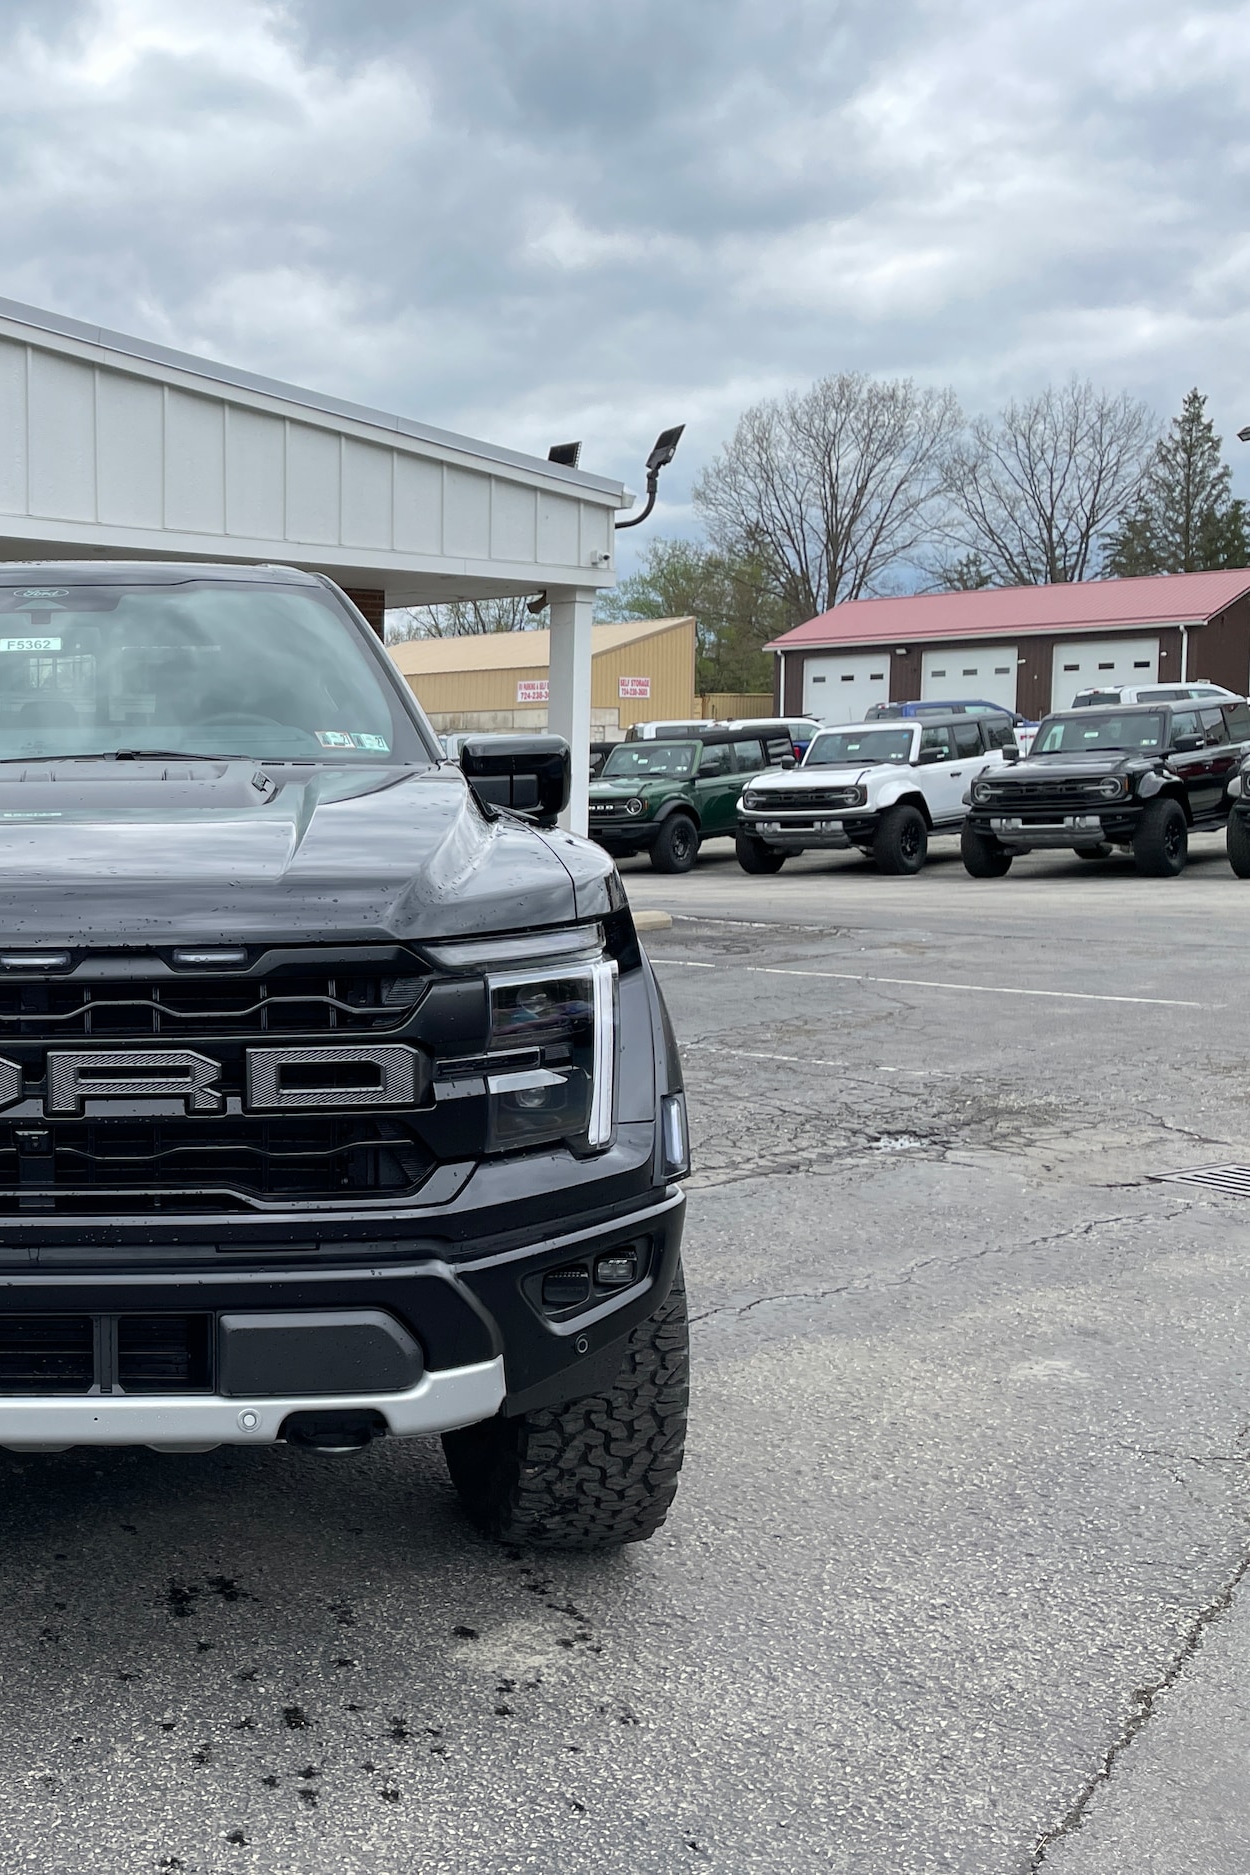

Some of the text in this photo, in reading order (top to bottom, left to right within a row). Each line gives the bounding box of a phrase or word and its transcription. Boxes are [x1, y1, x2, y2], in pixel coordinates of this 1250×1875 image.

[7, 639, 51, 650] F5362
[620, 679, 649, 687] SELF STORAGE
